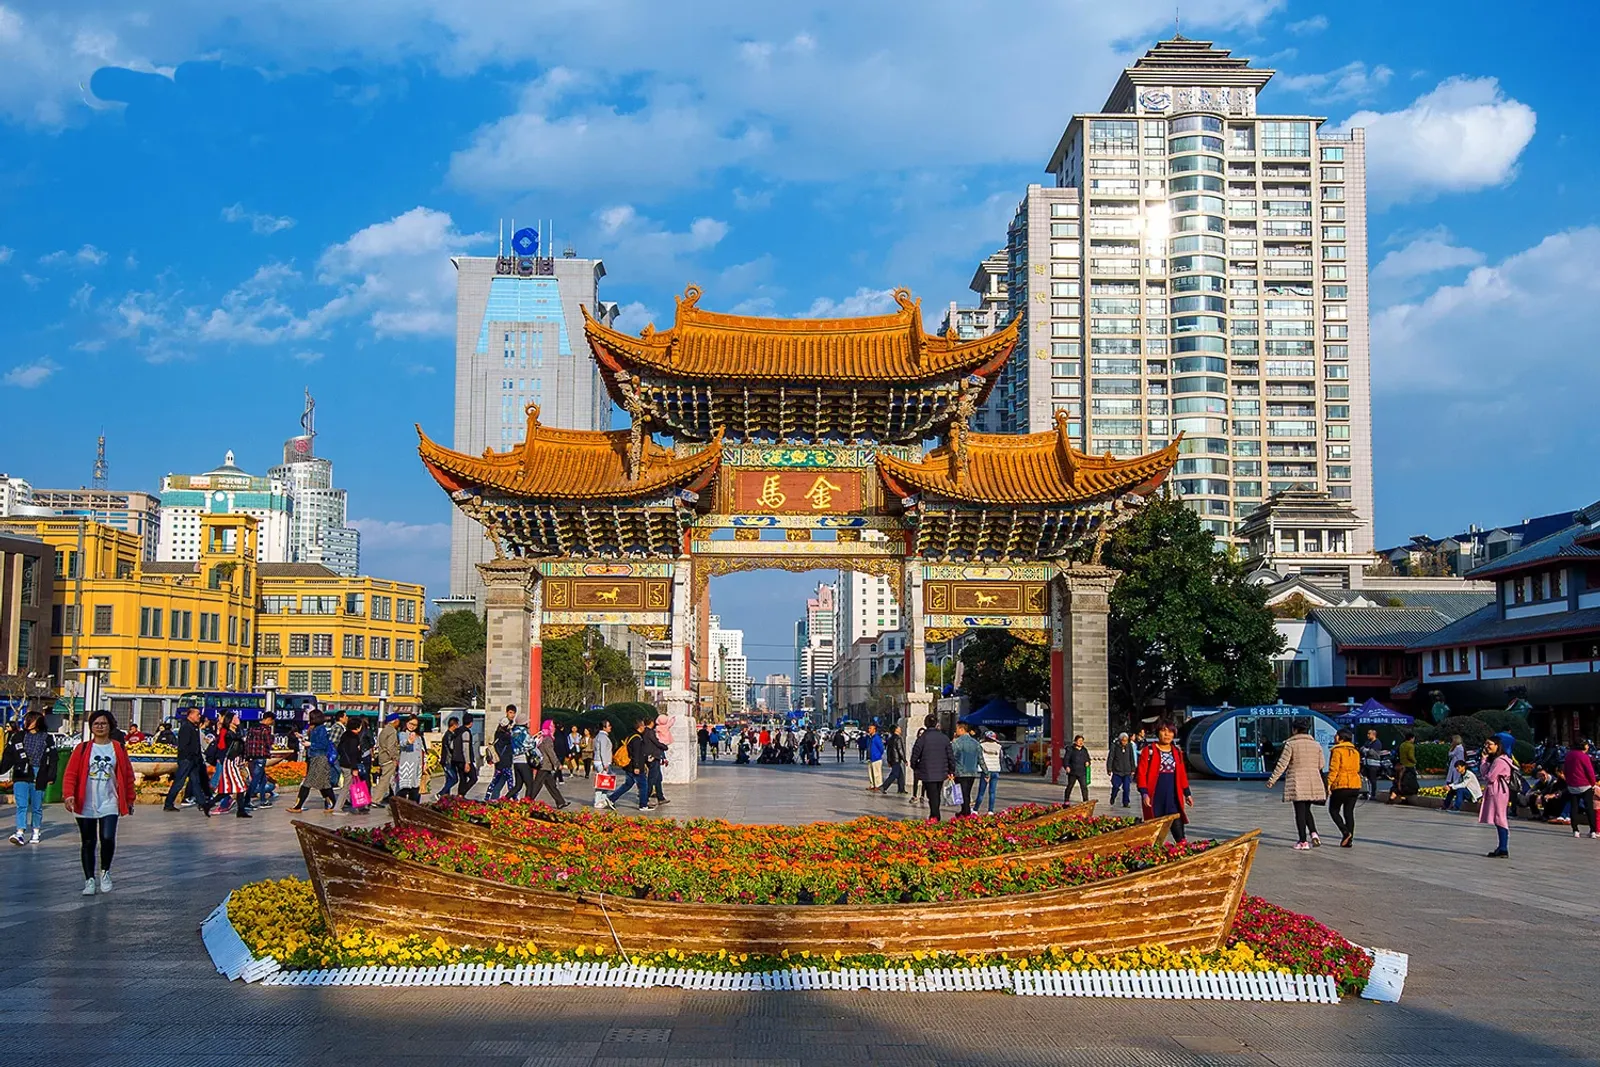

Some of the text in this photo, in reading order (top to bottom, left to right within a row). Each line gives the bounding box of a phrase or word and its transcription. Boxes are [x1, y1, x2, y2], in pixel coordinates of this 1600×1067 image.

[1250, 707, 1300, 716] 综合执法岗亭
